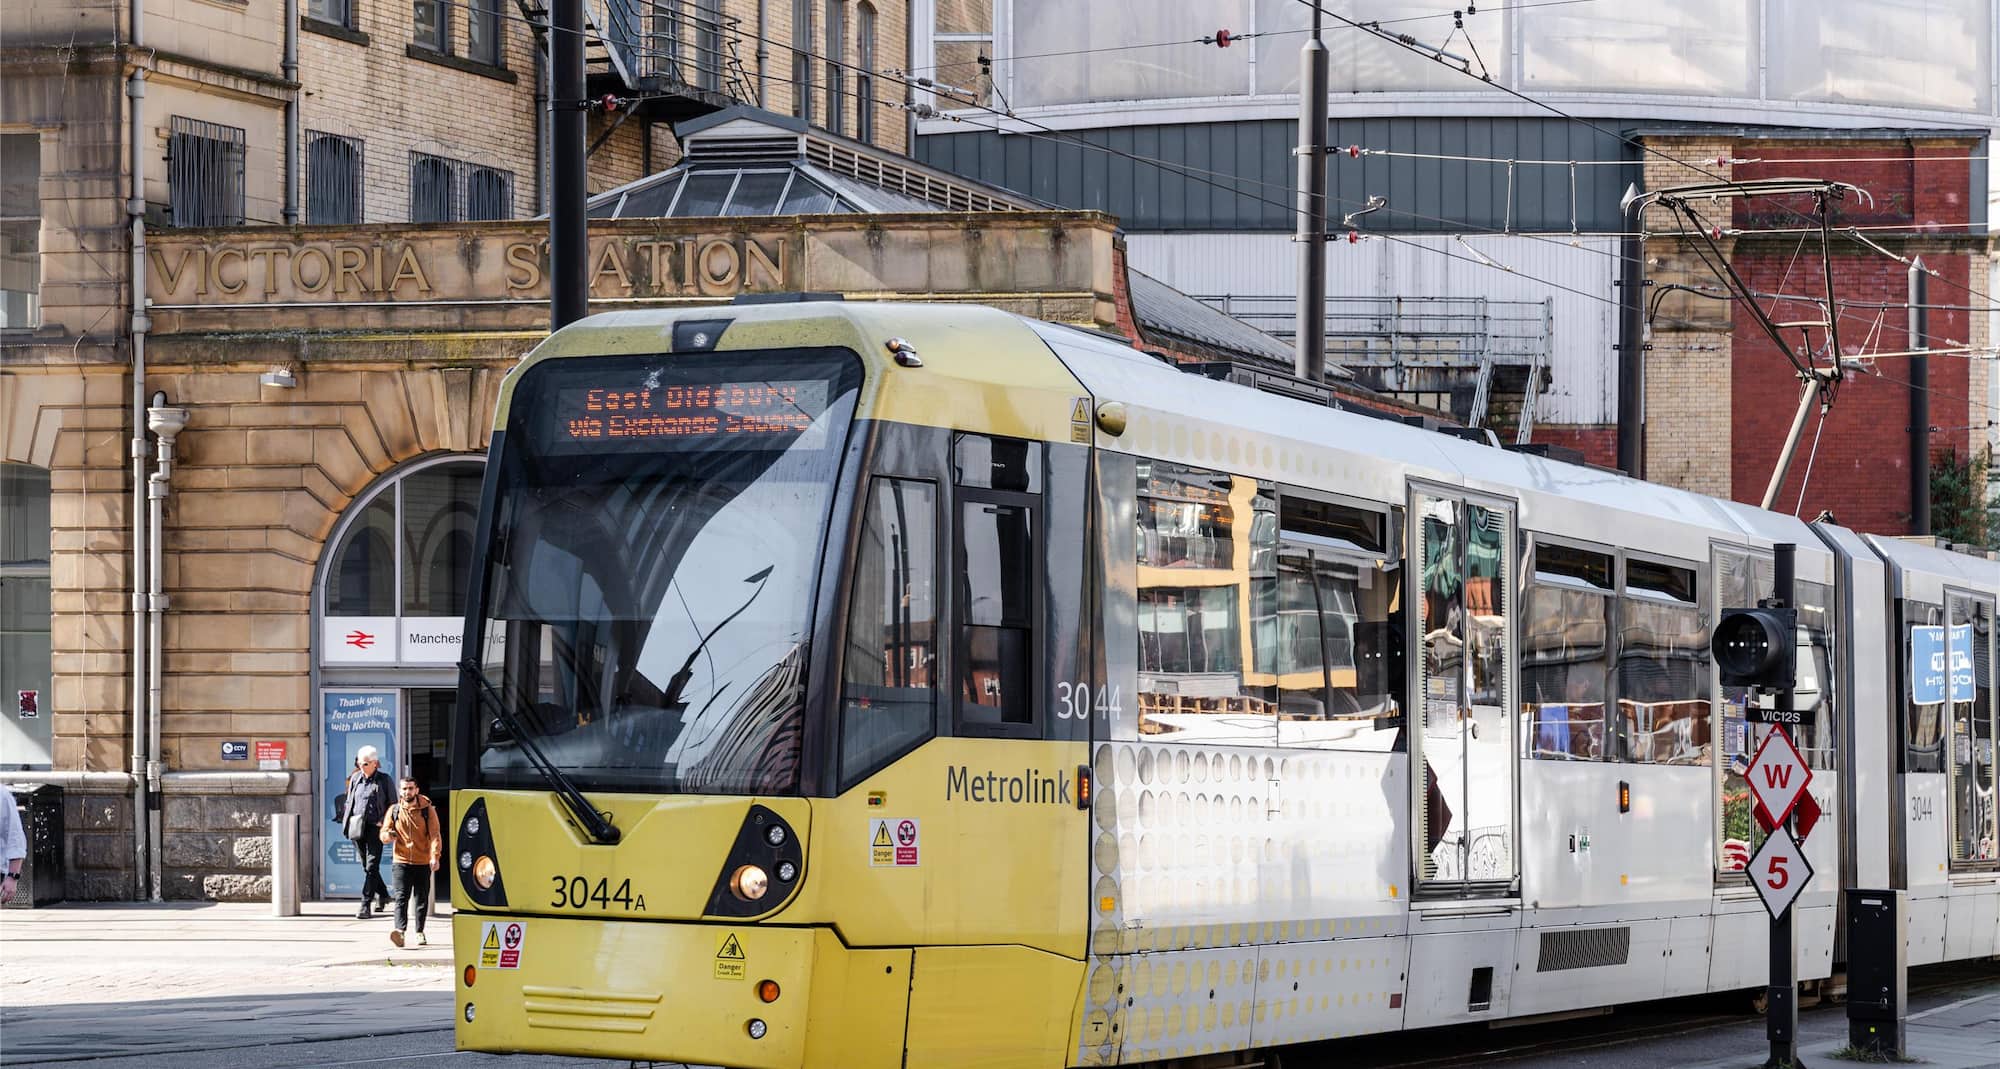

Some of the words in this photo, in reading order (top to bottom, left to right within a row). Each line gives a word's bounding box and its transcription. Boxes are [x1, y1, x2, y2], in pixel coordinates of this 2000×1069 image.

[150, 245, 431, 295] VICTORIA
[505, 238, 786, 290] SATION
[587, 388, 652, 411] East
[667, 385, 797, 408] Didsbury
[569, 416, 602, 437] via
[607, 413, 719, 437] Exchange
[725, 412, 809, 433] Square
[409, 632, 464, 645] Manches
[332, 709, 346, 720] for
[347, 706, 389, 719] travelling
[339, 696, 365, 707] Thank
[366, 696, 383, 706] you
[1057, 681, 1122, 721] 3044
[331, 722, 351, 731] with
[352, 720, 391, 731] Northern
[1761, 710, 1801, 723] VIC12S
[946, 765, 1071, 804] Metrolink
[1763, 764, 1793, 789] W
[1911, 796, 1933, 821] 3044
[1767, 856, 1788, 890] 5
